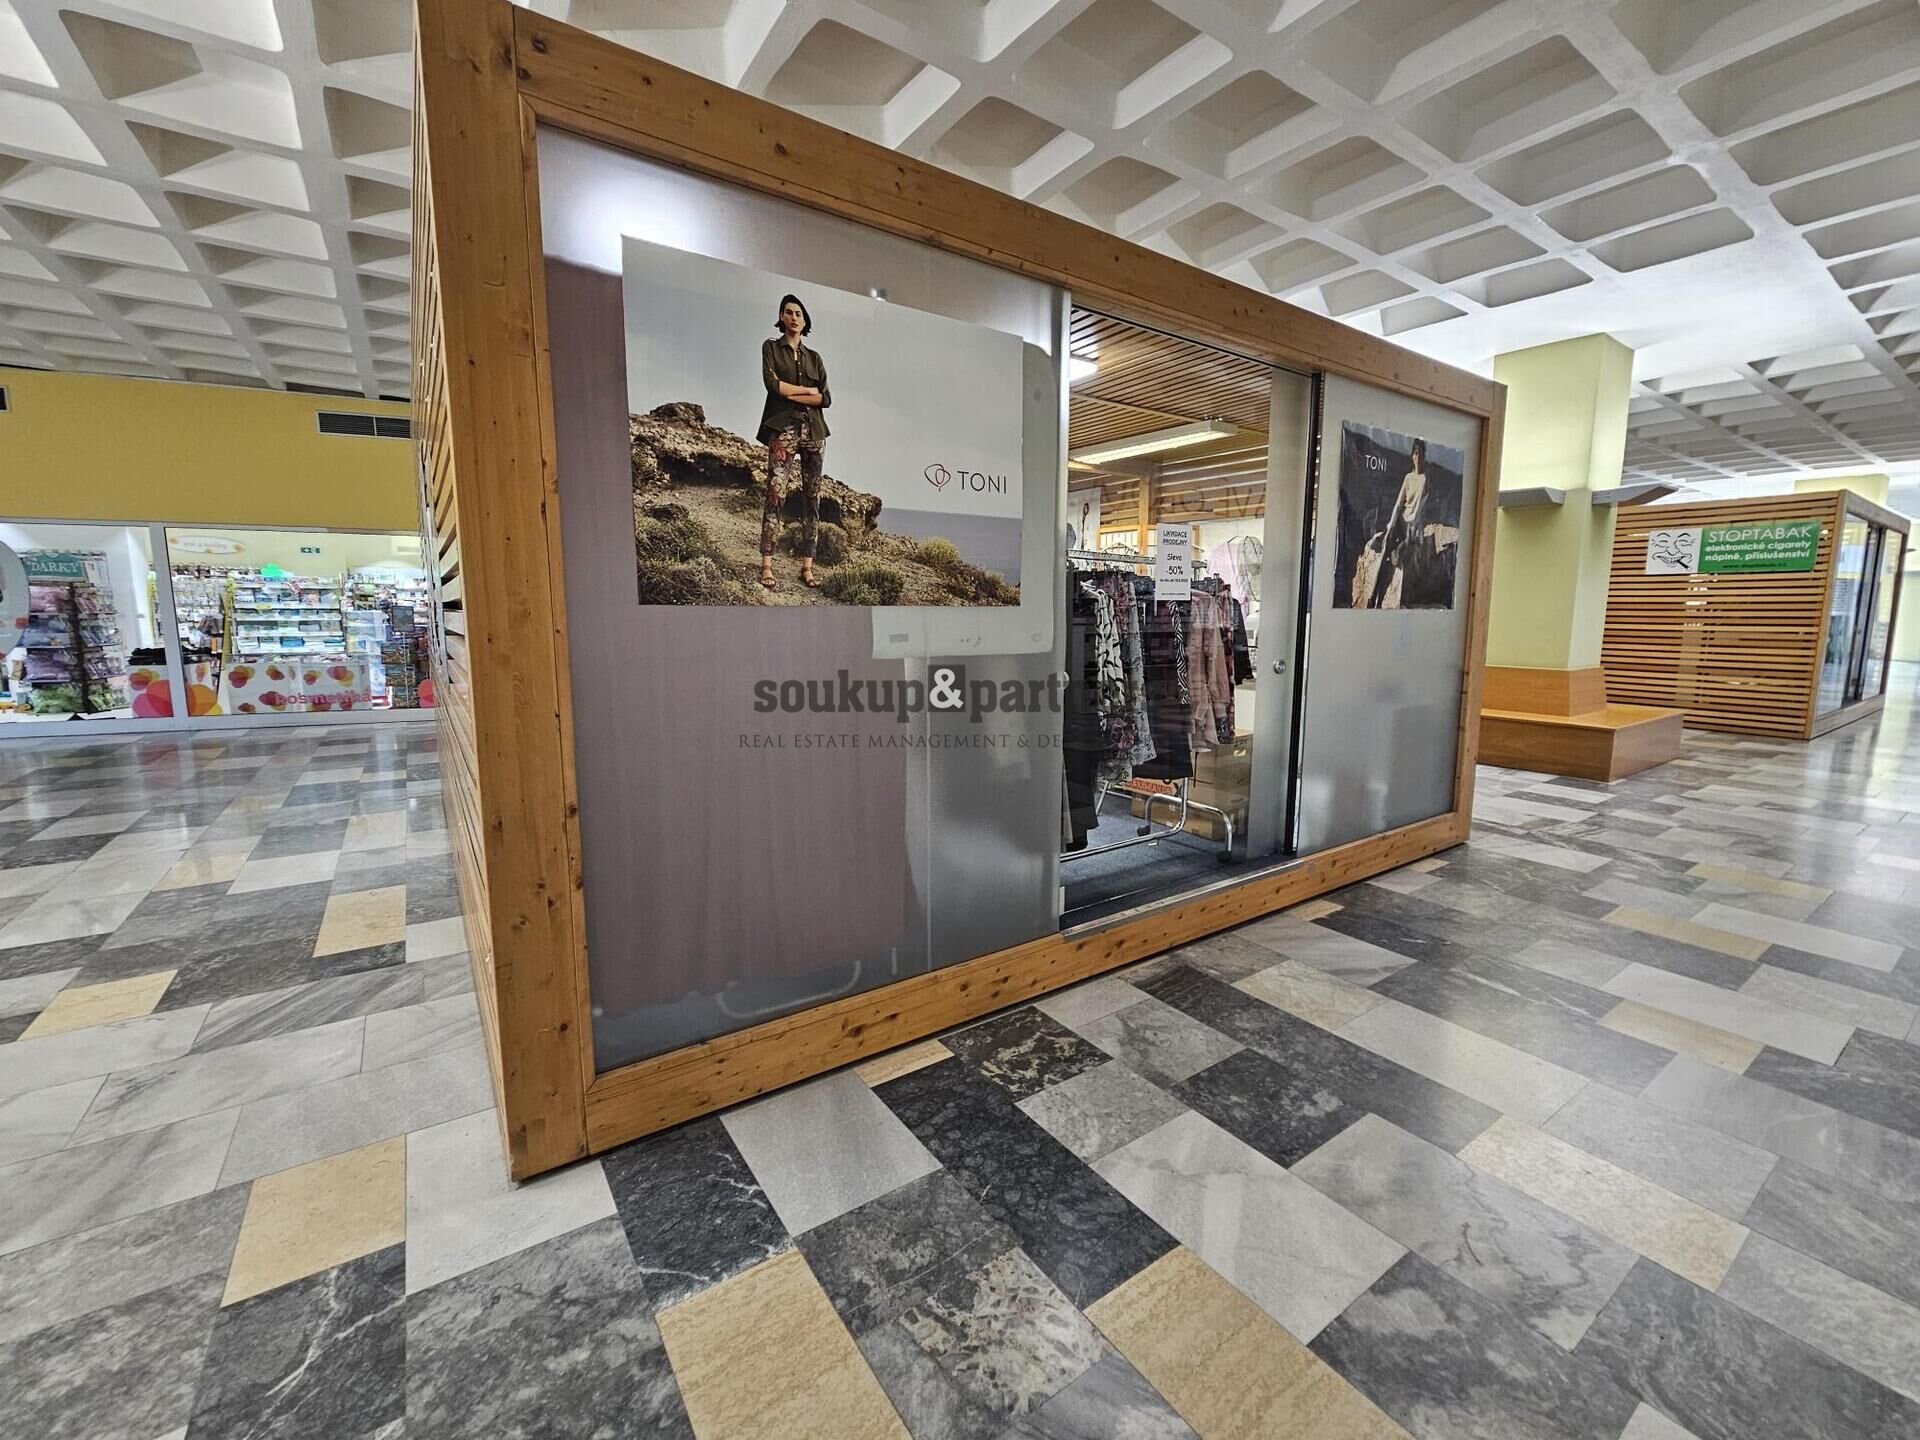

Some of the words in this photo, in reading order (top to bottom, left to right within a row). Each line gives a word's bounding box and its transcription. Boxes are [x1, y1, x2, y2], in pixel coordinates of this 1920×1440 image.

[1364, 454, 1387, 472] TONI
[956, 470, 1007, 494] TONI
[1163, 530, 1188, 538] LIKVIDACE
[1708, 527, 1812, 543] STOPTABAK
[1163, 538, 1187, 546] PRODEJNY
[1705, 541, 1765, 552] elektronické
[1767, 540, 1812, 550] cigarety
[1167, 553, 1183, 561] Sleva
[1745, 549, 1811, 561] příslušenství
[1165, 565, 1184, 575] -50%
